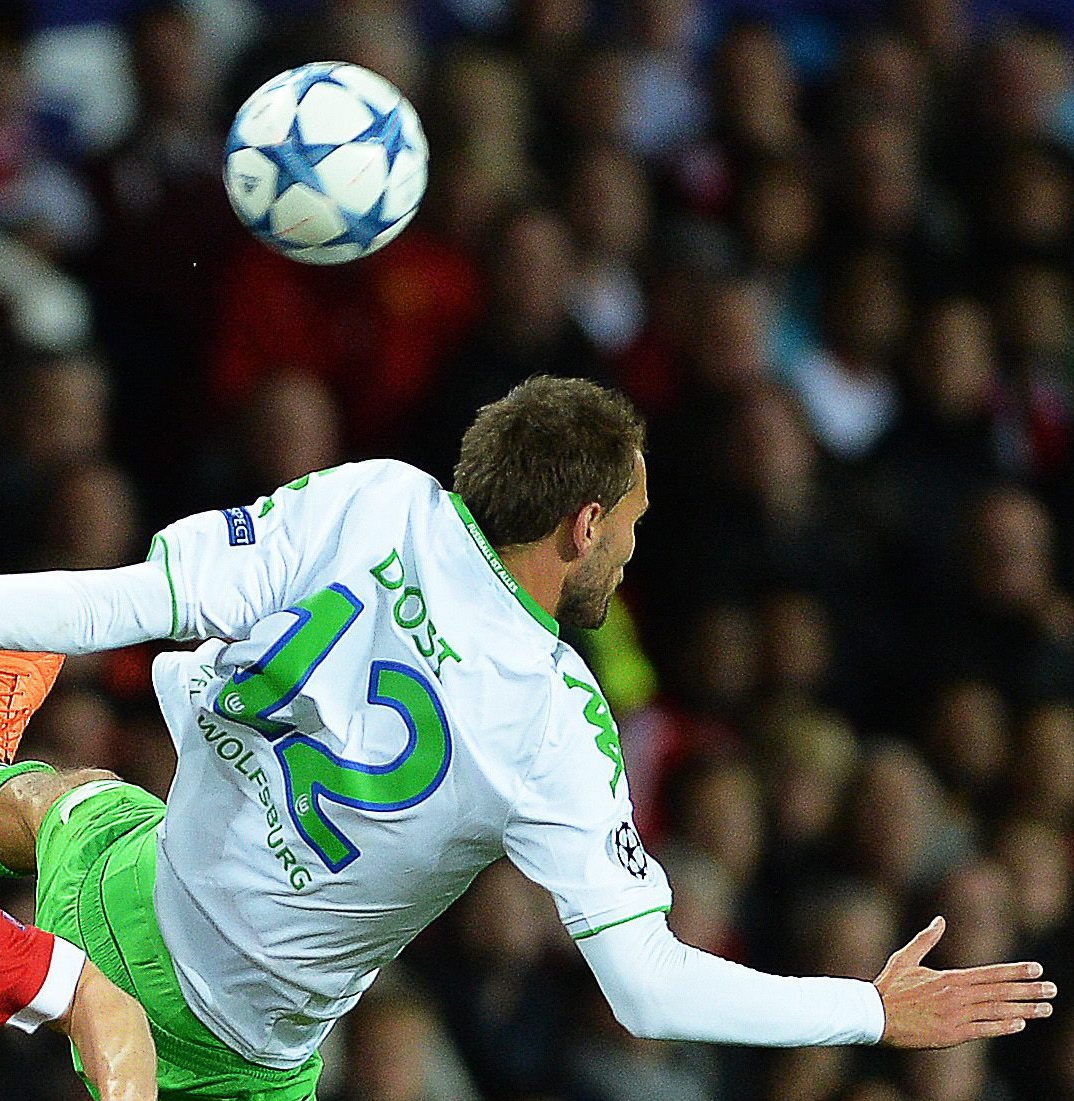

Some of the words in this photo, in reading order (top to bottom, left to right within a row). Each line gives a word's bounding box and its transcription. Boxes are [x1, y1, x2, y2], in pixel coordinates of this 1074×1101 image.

[369, 547, 462, 678] DOST
[197, 709, 313, 893] WOLFSBURG
[213, 580, 453, 875] 12
